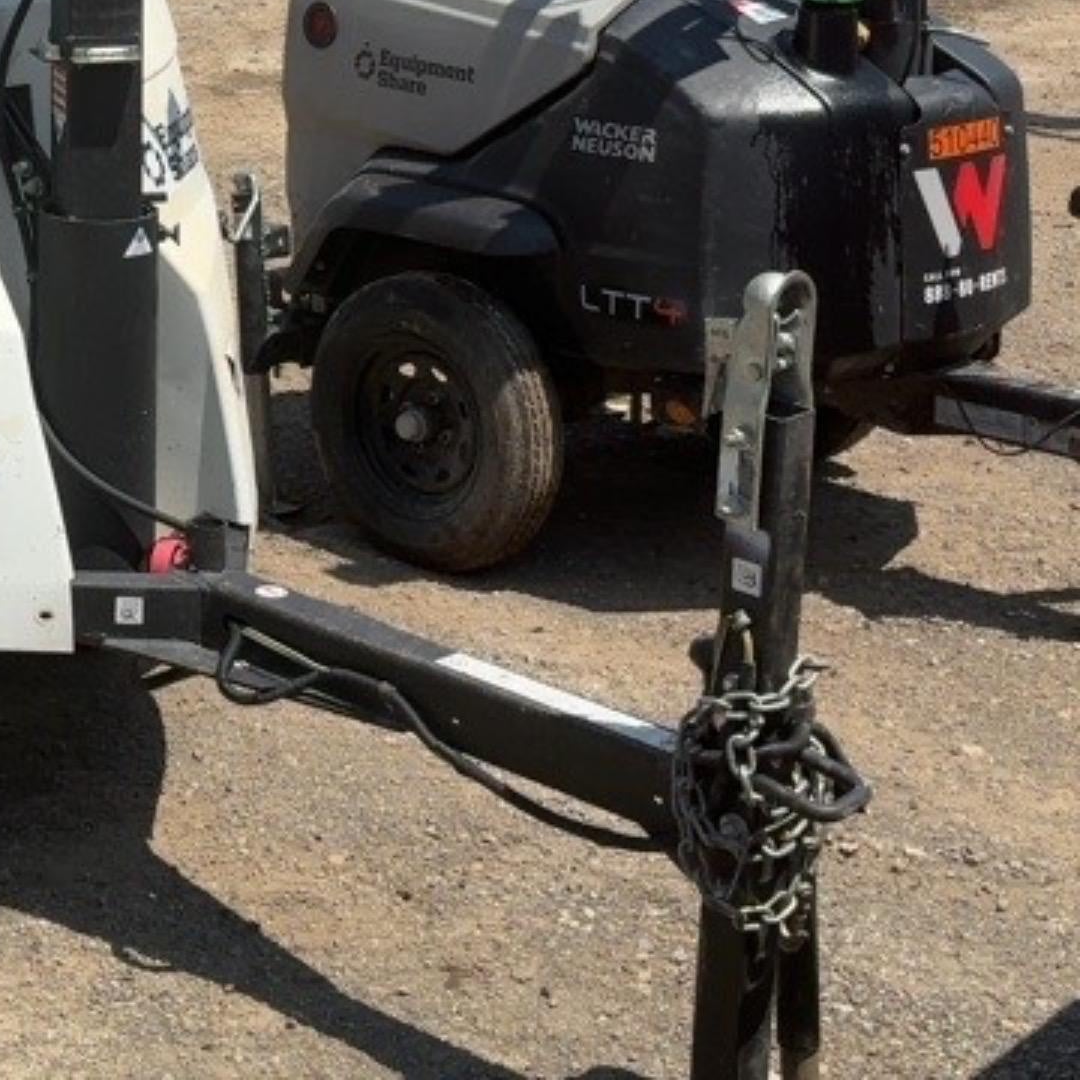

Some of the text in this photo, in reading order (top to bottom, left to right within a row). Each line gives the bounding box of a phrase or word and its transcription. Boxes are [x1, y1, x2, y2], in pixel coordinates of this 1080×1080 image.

[379, 49, 475, 85] Equipment
[376, 71, 427, 96] Share
[571, 135, 656, 163] NEUSON
